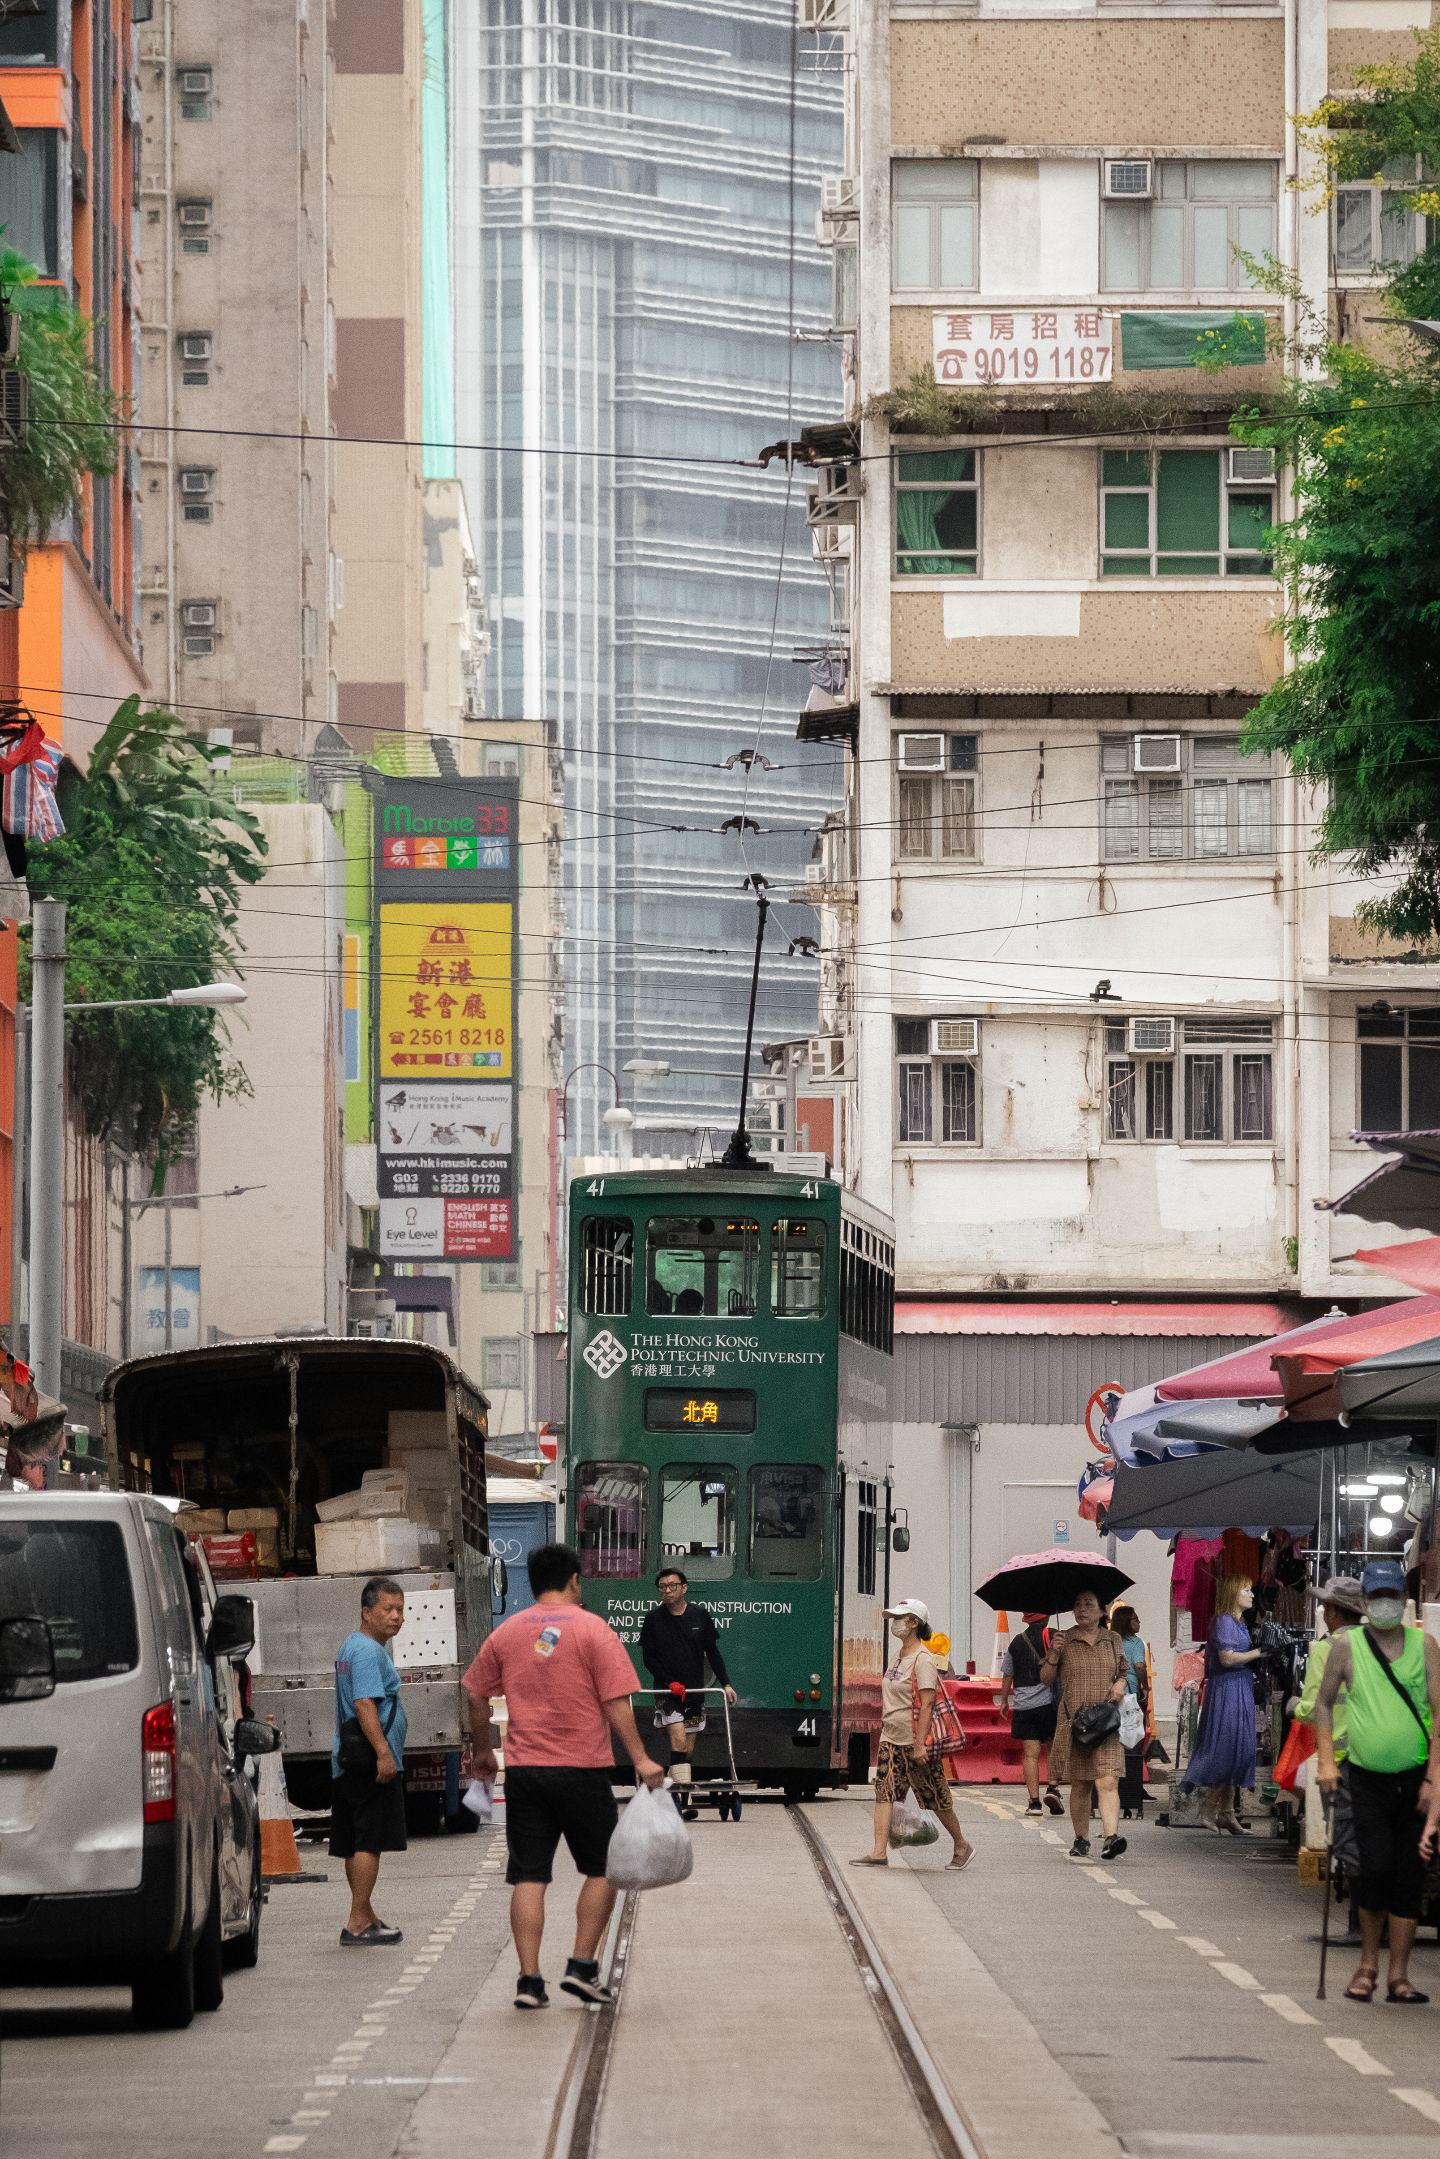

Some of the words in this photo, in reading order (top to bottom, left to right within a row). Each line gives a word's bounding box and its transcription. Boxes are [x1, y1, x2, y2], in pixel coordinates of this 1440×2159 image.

[946, 312, 1100, 341] 套房招租
[975, 349, 1039, 380] 9019
[1050, 346, 1110, 378] 1187
[478, 805, 510, 833] 33
[416, 958, 475, 987] 新港
[407, 991, 487, 1020] 宴會廳
[409, 1028, 453, 1046] 2561
[459, 1028, 505, 1046] 8218
[385, 1158, 508, 1168] www.hkimusic.com
[471, 1173, 500, 1183] 0170
[472, 1184, 500, 1193] 7770
[586, 1179, 605, 1196] 41
[799, 1181, 819, 1199] 41
[447, 1203, 488, 1211] ENGLISH
[447, 1212, 476, 1220] MATH
[447, 1220, 488, 1229] CHINESE
[489, 1224, 507, 1233] 中文
[387, 1229, 406, 1241] Eye
[408, 1229, 438, 1240] Level
[147, 1308, 190, 1329] 教會
[630, 1333, 663, 1346] THE
[665, 1333, 712, 1347] HONG
[714, 1334, 759, 1348] KONG
[630, 1348, 735, 1363] POLYTECHNIC
[737, 1349, 825, 1364] UNIVERSITY
[630, 1363, 716, 1377] 香港理工大學
[683, 1400, 718, 1424] 北角
[607, 1615, 634, 1627] AND
[797, 1718, 817, 1736] 41
